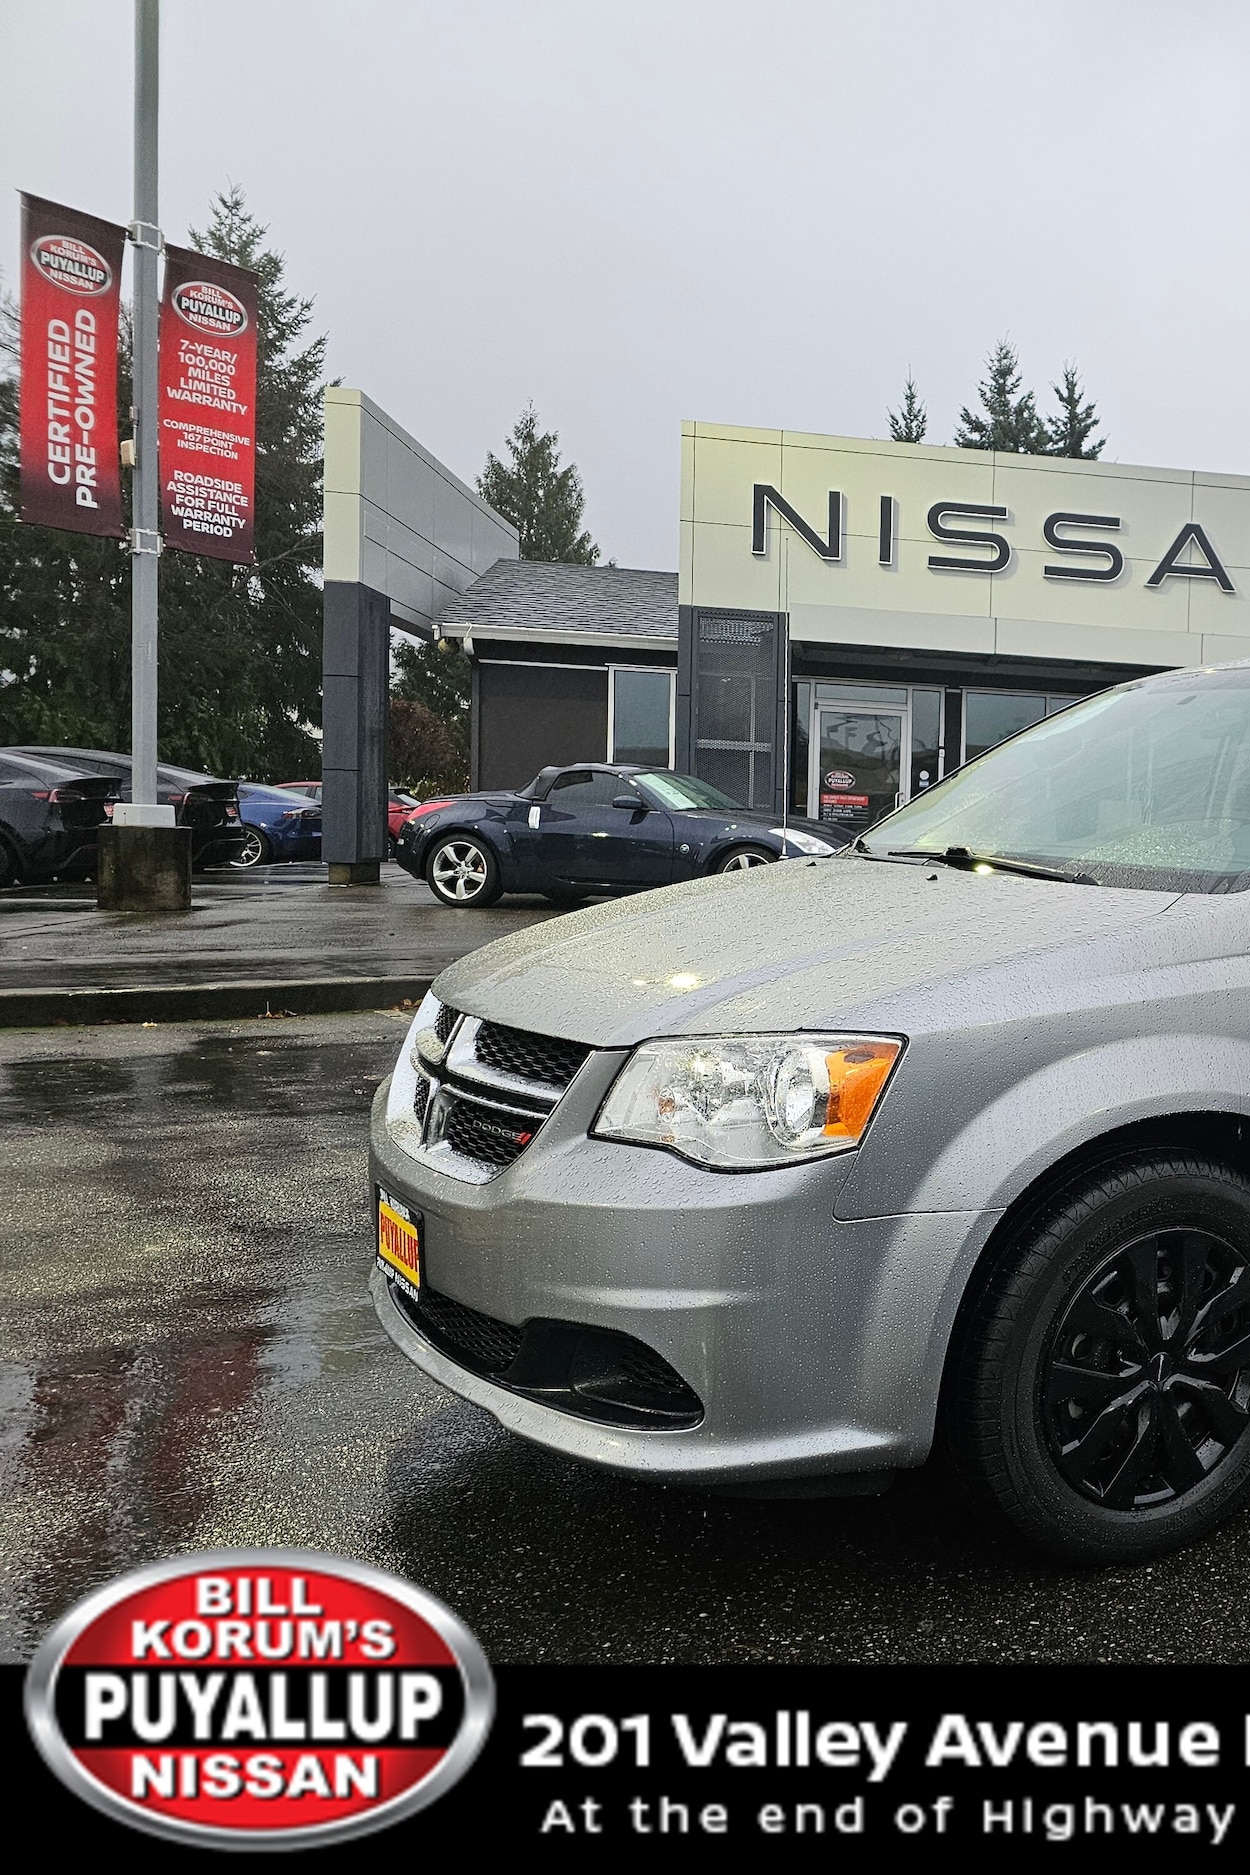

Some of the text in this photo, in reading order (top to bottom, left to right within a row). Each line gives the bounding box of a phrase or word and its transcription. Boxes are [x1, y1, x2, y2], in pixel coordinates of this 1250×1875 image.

[50, 244, 97, 266] KORUM'S
[62, 240, 85, 254] BILL
[41, 251, 105, 282] PUYALLUP
[50, 269, 94, 290] NISSAN
[189, 290, 234, 309] KORUM'S
[202, 286, 222, 299] BILL
[181, 297, 241, 325] PUYALLUP
[189, 313, 231, 331] NISSAN
[180, 339, 238, 364] 7-YEAR/
[178, 352, 236, 376] 100,000
[187, 366, 231, 387] MILES
[180, 377, 236, 400] LIMITED
[47, 318, 71, 486] CERTIFIED
[74, 308, 98, 509] PRE-OWNED
[166, 386, 248, 415] WARRANTY
[163, 419, 251, 446] COMPREHENSIVE
[183, 432, 235, 450] 167 POINT
[177, 439, 239, 460] INSPECTION
[174, 470, 243, 494] ROADSIDE
[166, 481, 249, 507] ASSISTANCE
[175, 494, 240, 517] FOR FULL
[171, 504, 247, 529] WARRANTY
[183, 519, 233, 538] PERIOD
[473, 1120, 522, 1143] DODGE
